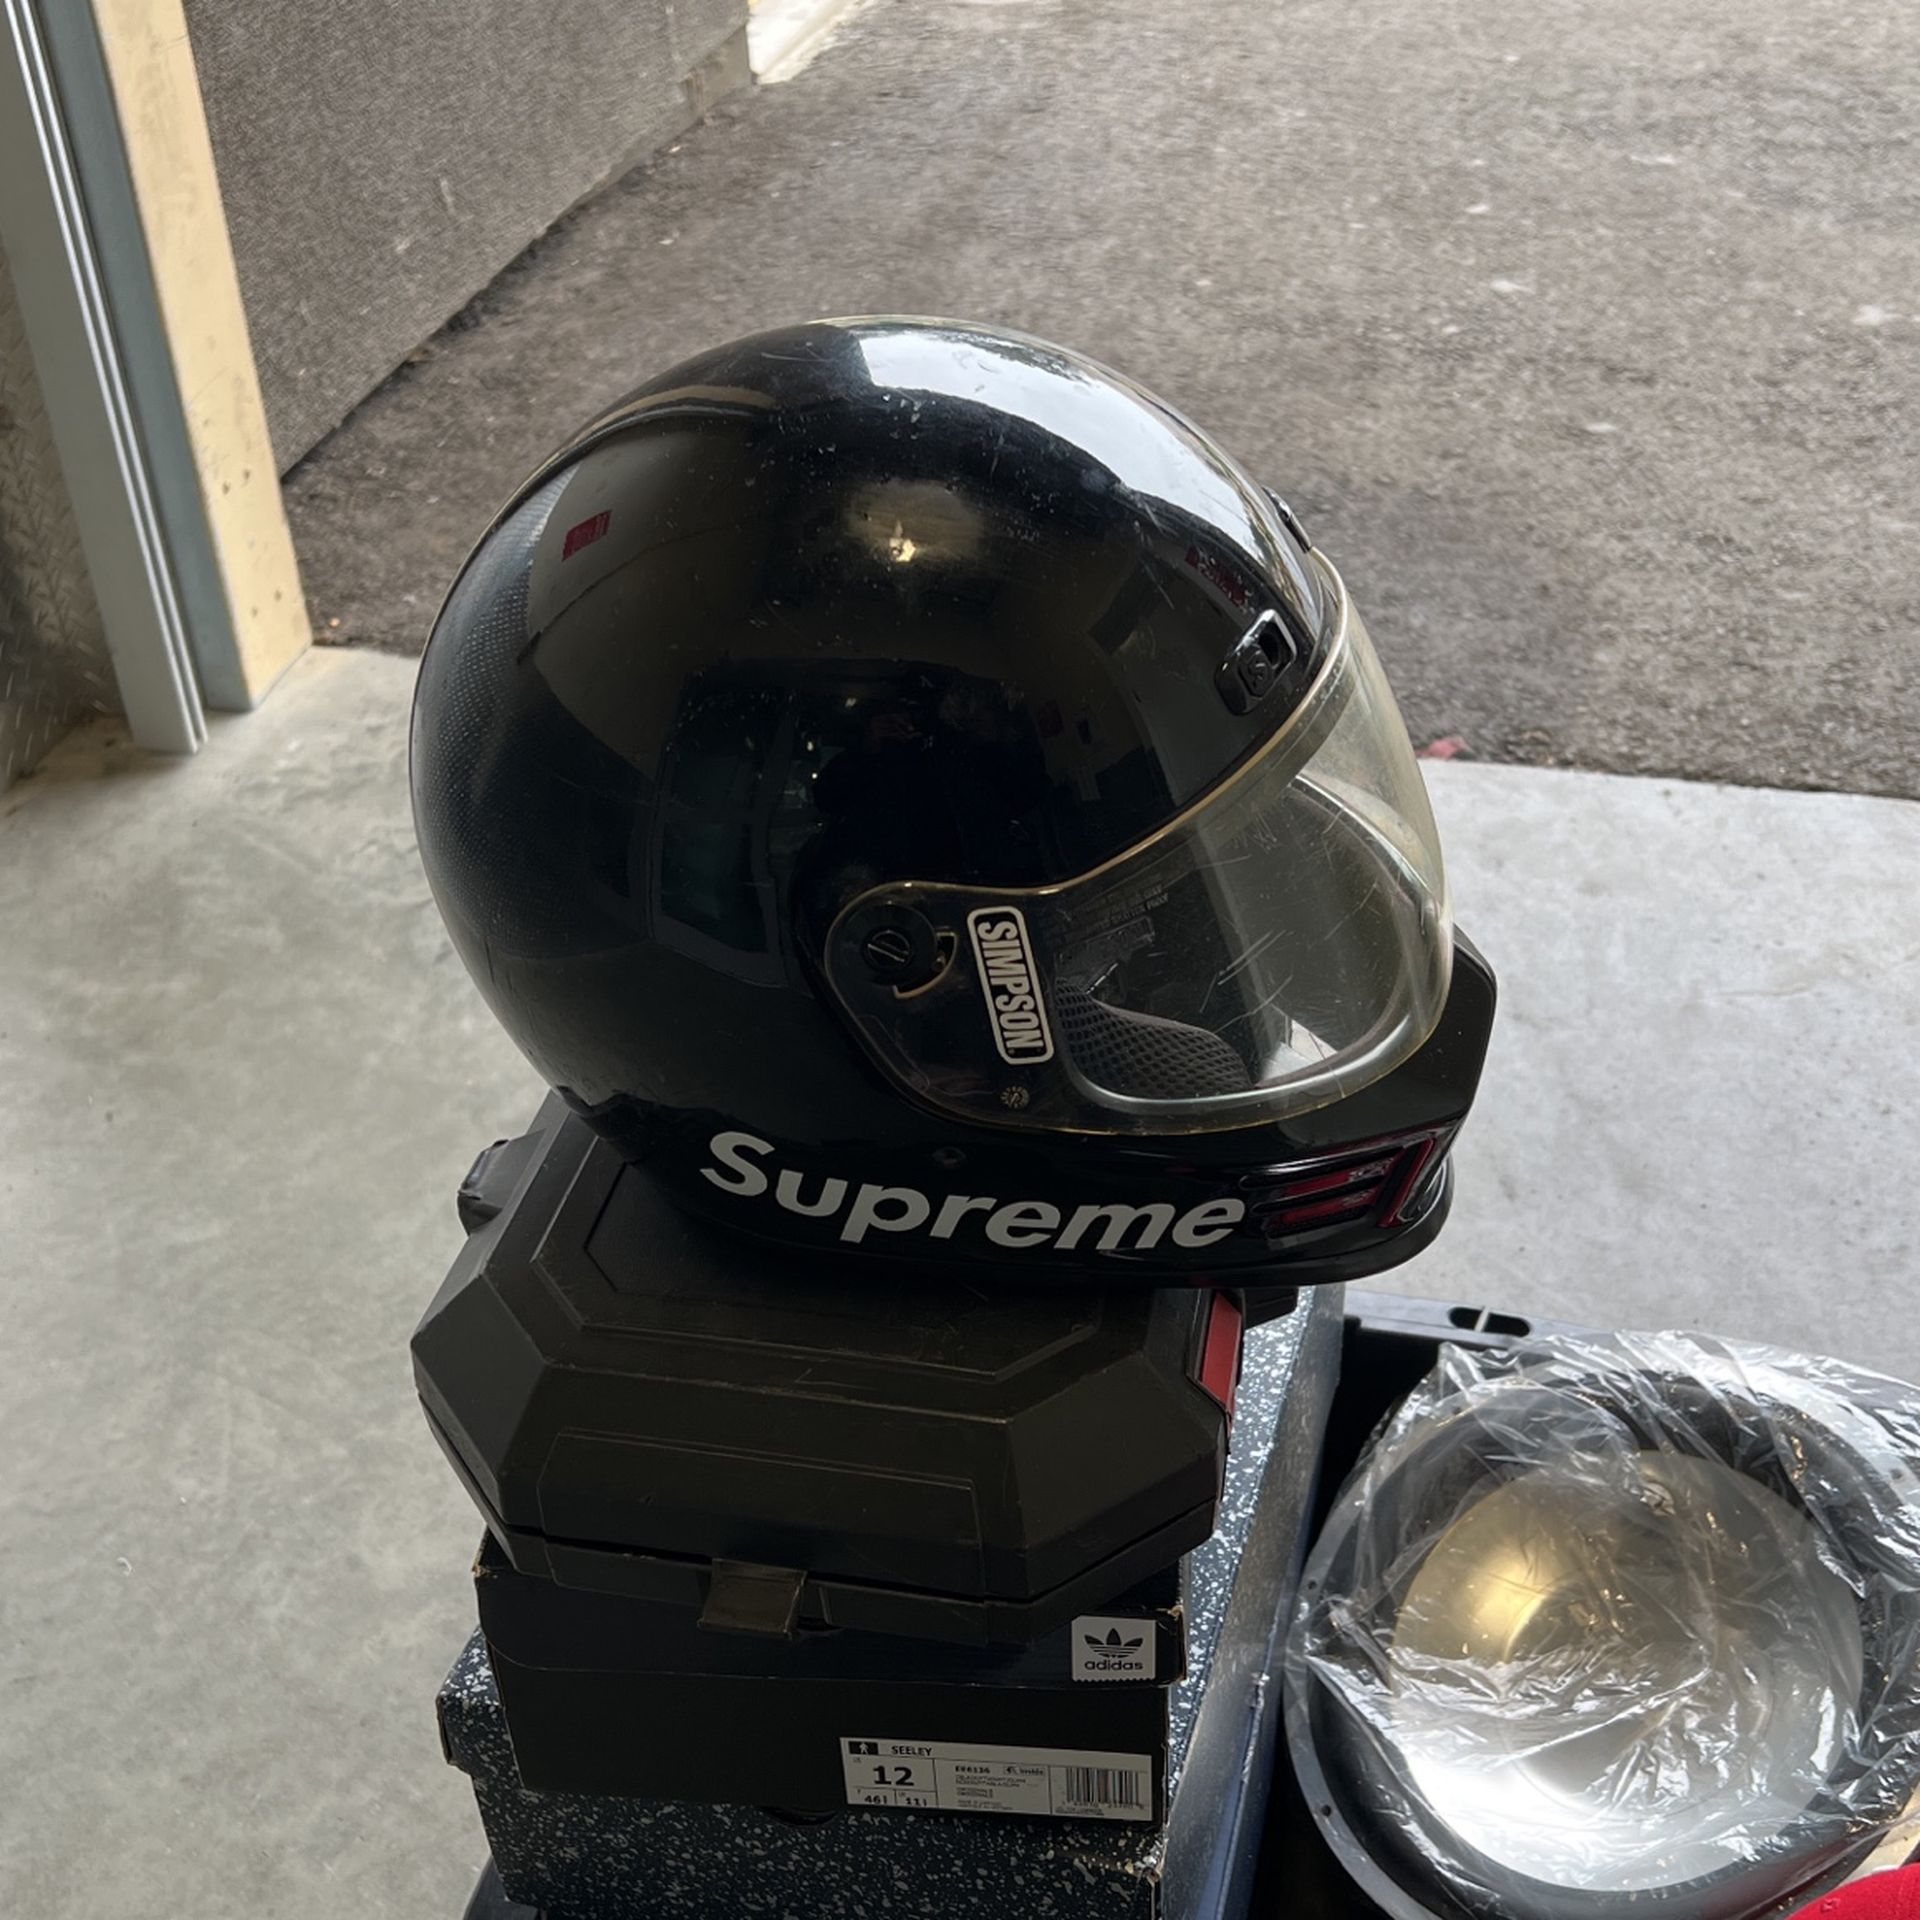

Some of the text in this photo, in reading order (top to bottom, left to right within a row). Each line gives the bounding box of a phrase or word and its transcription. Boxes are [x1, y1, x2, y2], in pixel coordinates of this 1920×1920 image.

[977, 921, 1044, 1049] SIMPSON
[700, 1131, 1246, 1250] Supreme
[1084, 1659, 1143, 1671] adidas
[891, 1745, 932, 1757] SEELEY
[873, 1765, 914, 1786] 12
